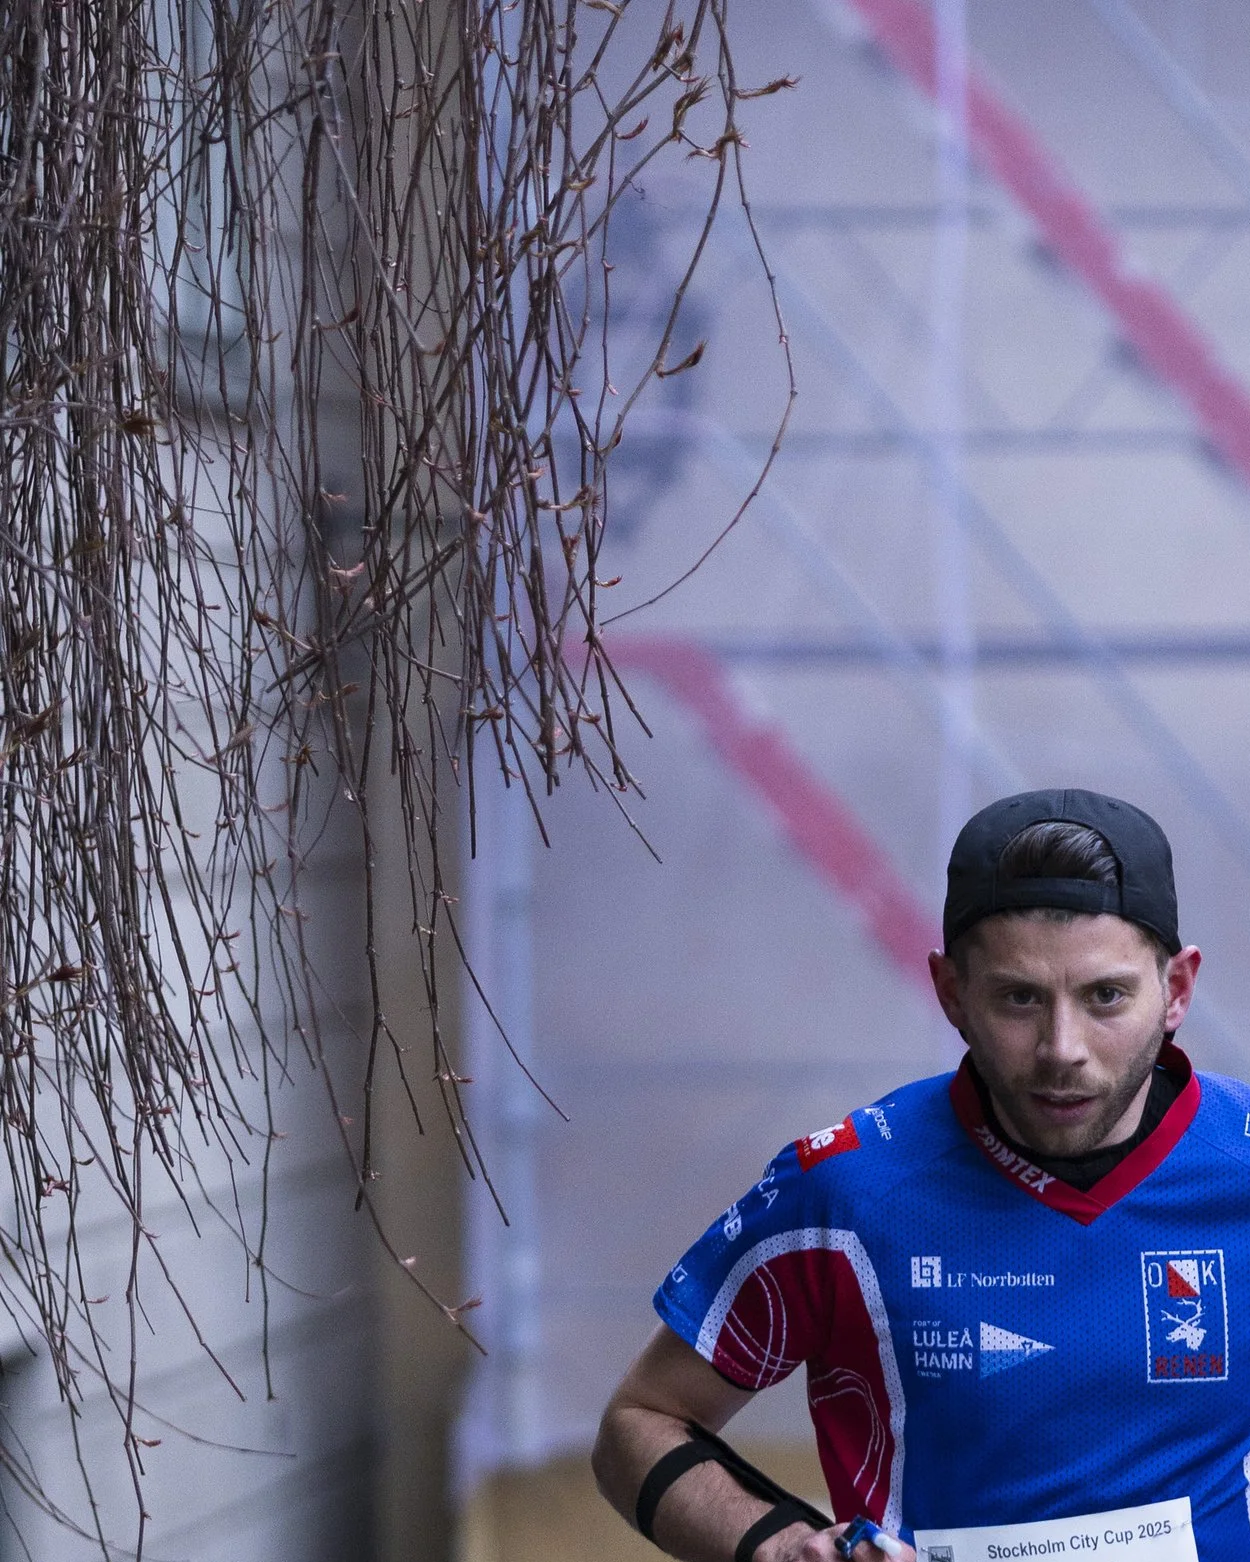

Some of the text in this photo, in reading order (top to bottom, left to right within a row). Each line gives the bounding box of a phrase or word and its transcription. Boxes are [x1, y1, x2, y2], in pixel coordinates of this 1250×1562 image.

[974, 1125, 1057, 1194] TRIMTEX
[947, 1272, 1055, 1288] LF Norrbotten
[913, 1327, 974, 1348] LULEÅ
[914, 1351, 973, 1370] HAMN
[1155, 1354, 1223, 1378] RENEN
[987, 1519, 1172, 1559] Stockholm City Cup 2025
